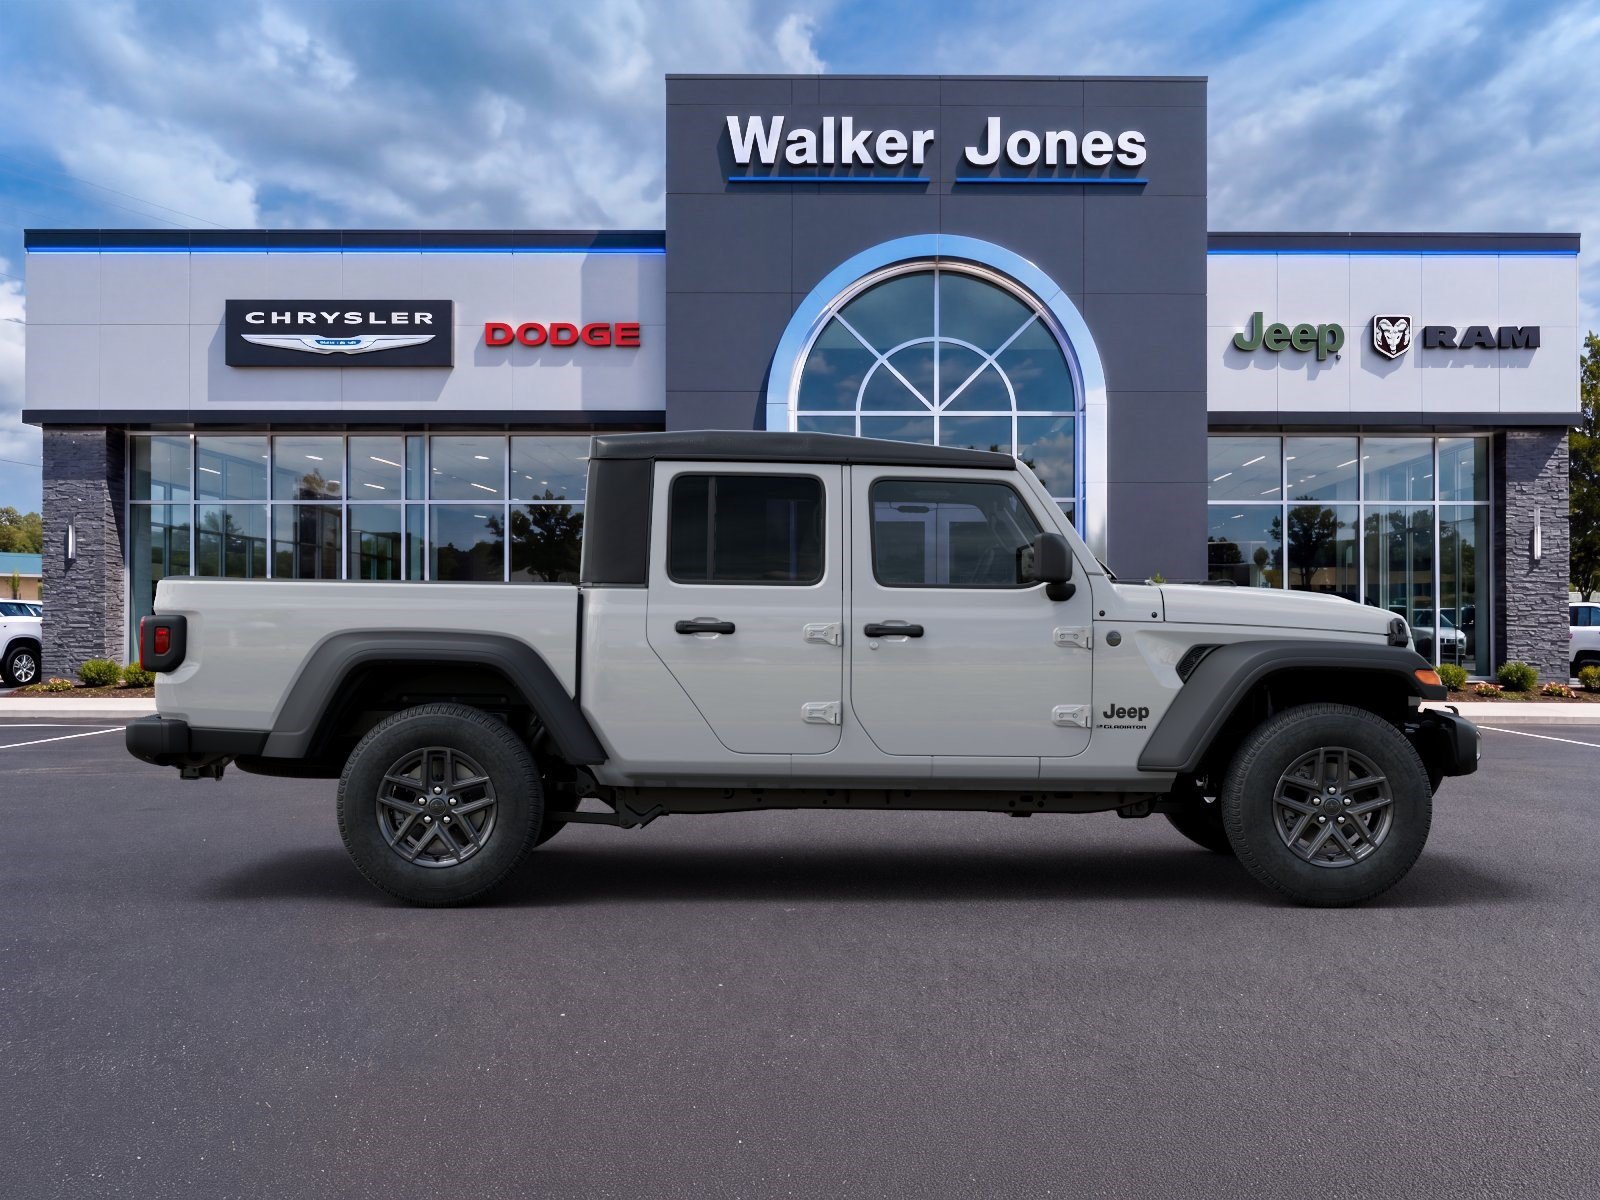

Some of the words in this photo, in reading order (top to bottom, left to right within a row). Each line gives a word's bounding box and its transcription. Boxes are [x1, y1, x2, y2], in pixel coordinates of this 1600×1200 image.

[726, 115, 935, 166] Walker
[964, 116, 1148, 167] Jones
[245, 311, 434, 325] CHRYSLER
[484, 322, 641, 347] DODGE
[1233, 311, 1345, 361] Jeep
[1423, 325, 1541, 349] RAM
[1103, 703, 1149, 721] Jeep
